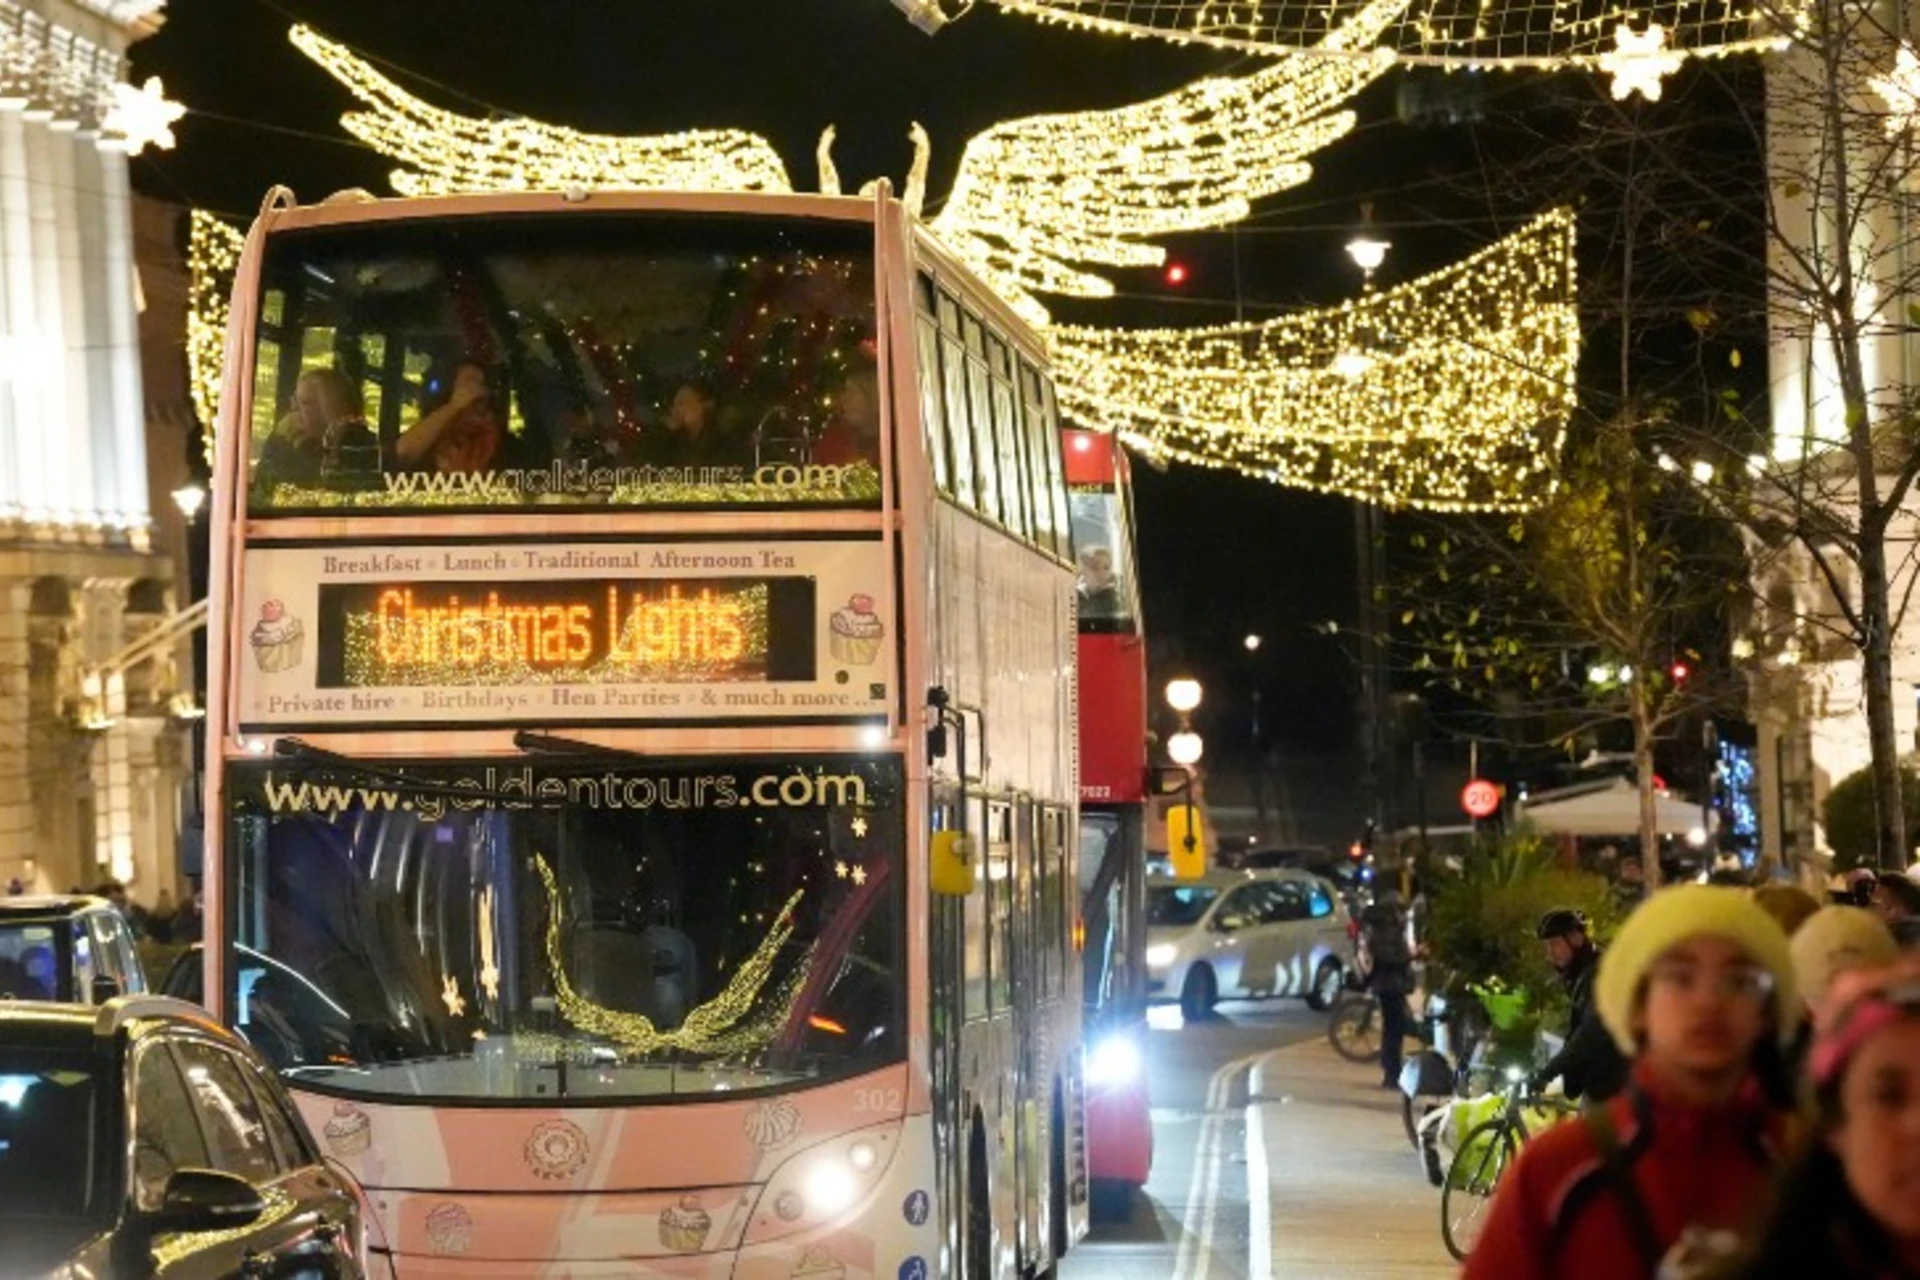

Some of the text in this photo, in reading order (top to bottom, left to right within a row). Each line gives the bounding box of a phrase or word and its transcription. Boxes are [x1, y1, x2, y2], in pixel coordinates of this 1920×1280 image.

[322, 550, 796, 574] Breakfast Lunch Traditional Afternoon Tea
[376, 585, 743, 663] Christmas Lights
[267, 695, 345, 714] Private
[351, 693, 396, 711] hire
[421, 690, 529, 712] Birthdays
[551, 688, 597, 707] Hen
[602, 687, 681, 707] Parties
[723, 687, 786, 707] much
[1469, 791, 1493, 806] 20
[852, 1088, 903, 1113] 302
